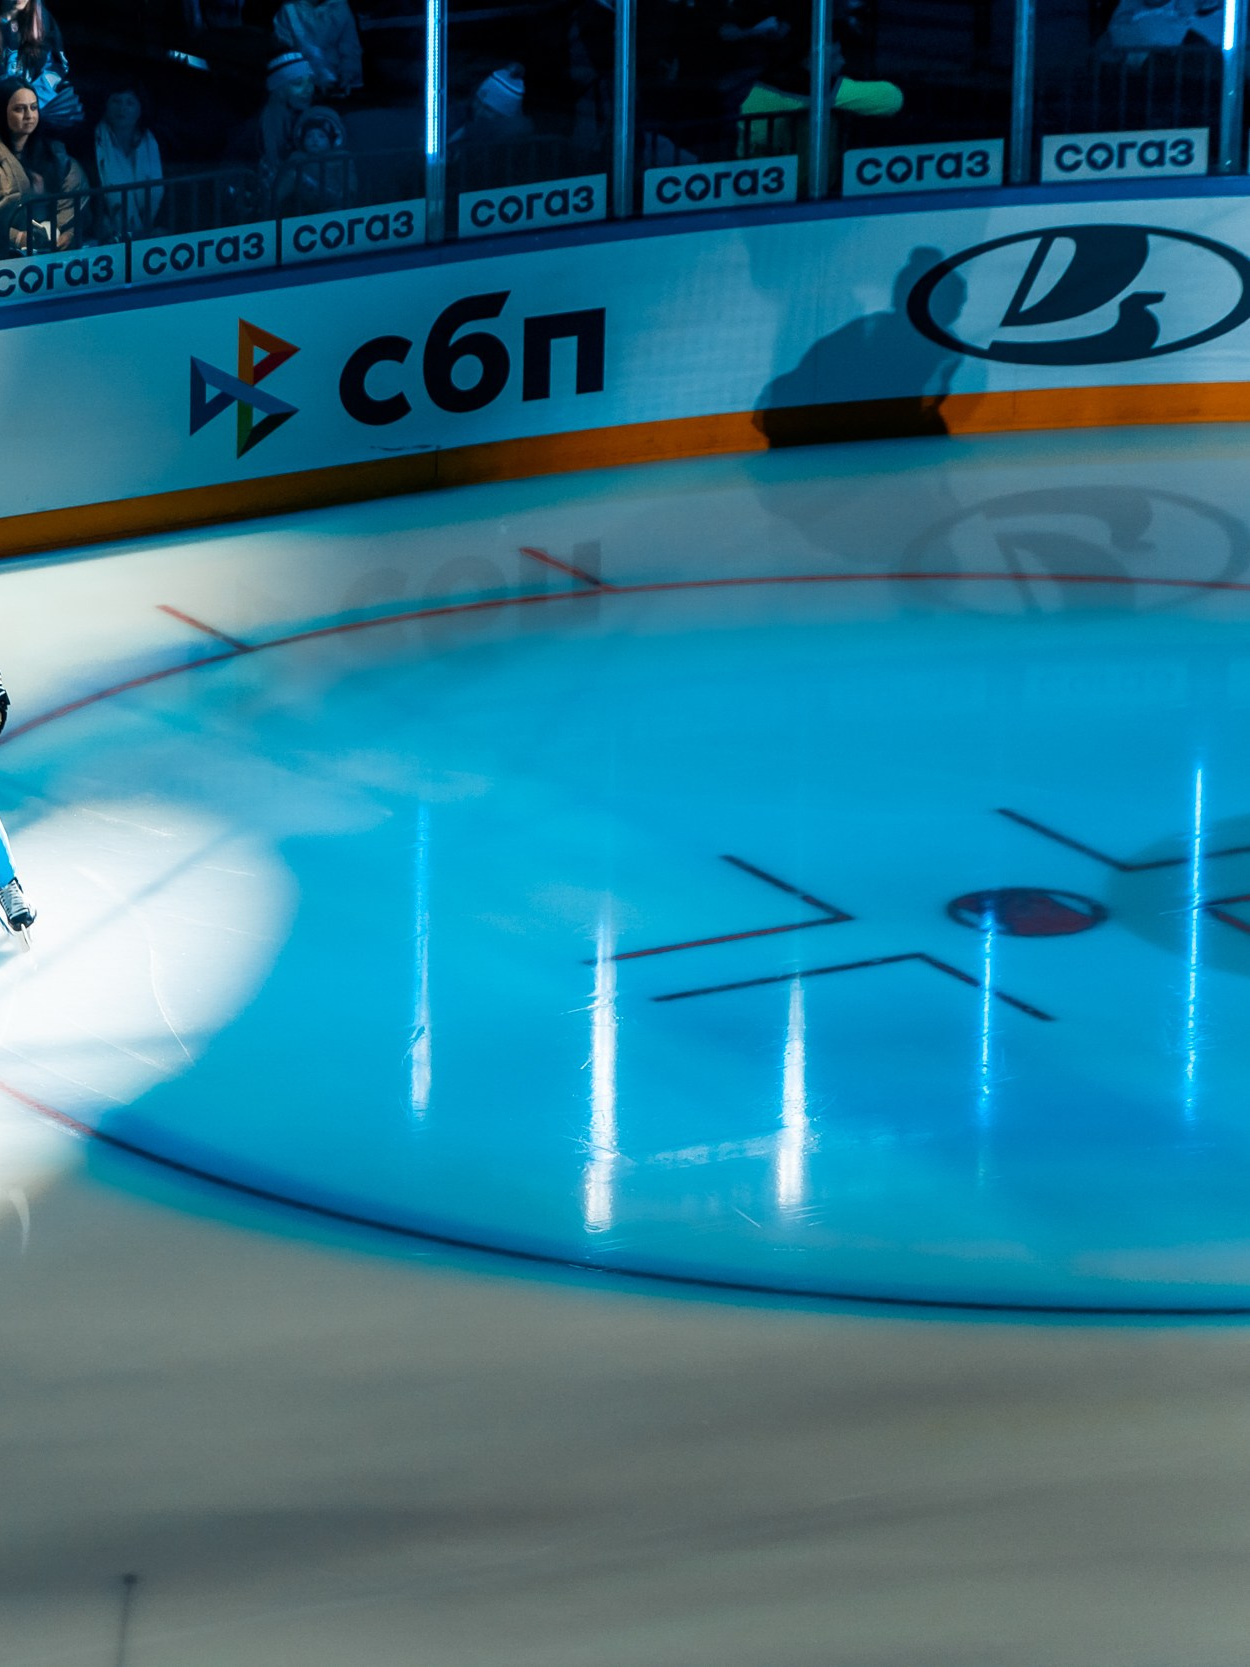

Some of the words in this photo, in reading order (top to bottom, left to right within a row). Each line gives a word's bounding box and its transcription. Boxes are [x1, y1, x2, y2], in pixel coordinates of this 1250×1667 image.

[855, 150, 991, 186] согаз
[1054, 137, 1196, 172] согаз
[470, 185, 595, 228] согаз
[656, 166, 786, 205] согаз
[293, 210, 415, 254] согаз
[142, 232, 265, 276] согаз
[338, 290, 607, 426] сбп
